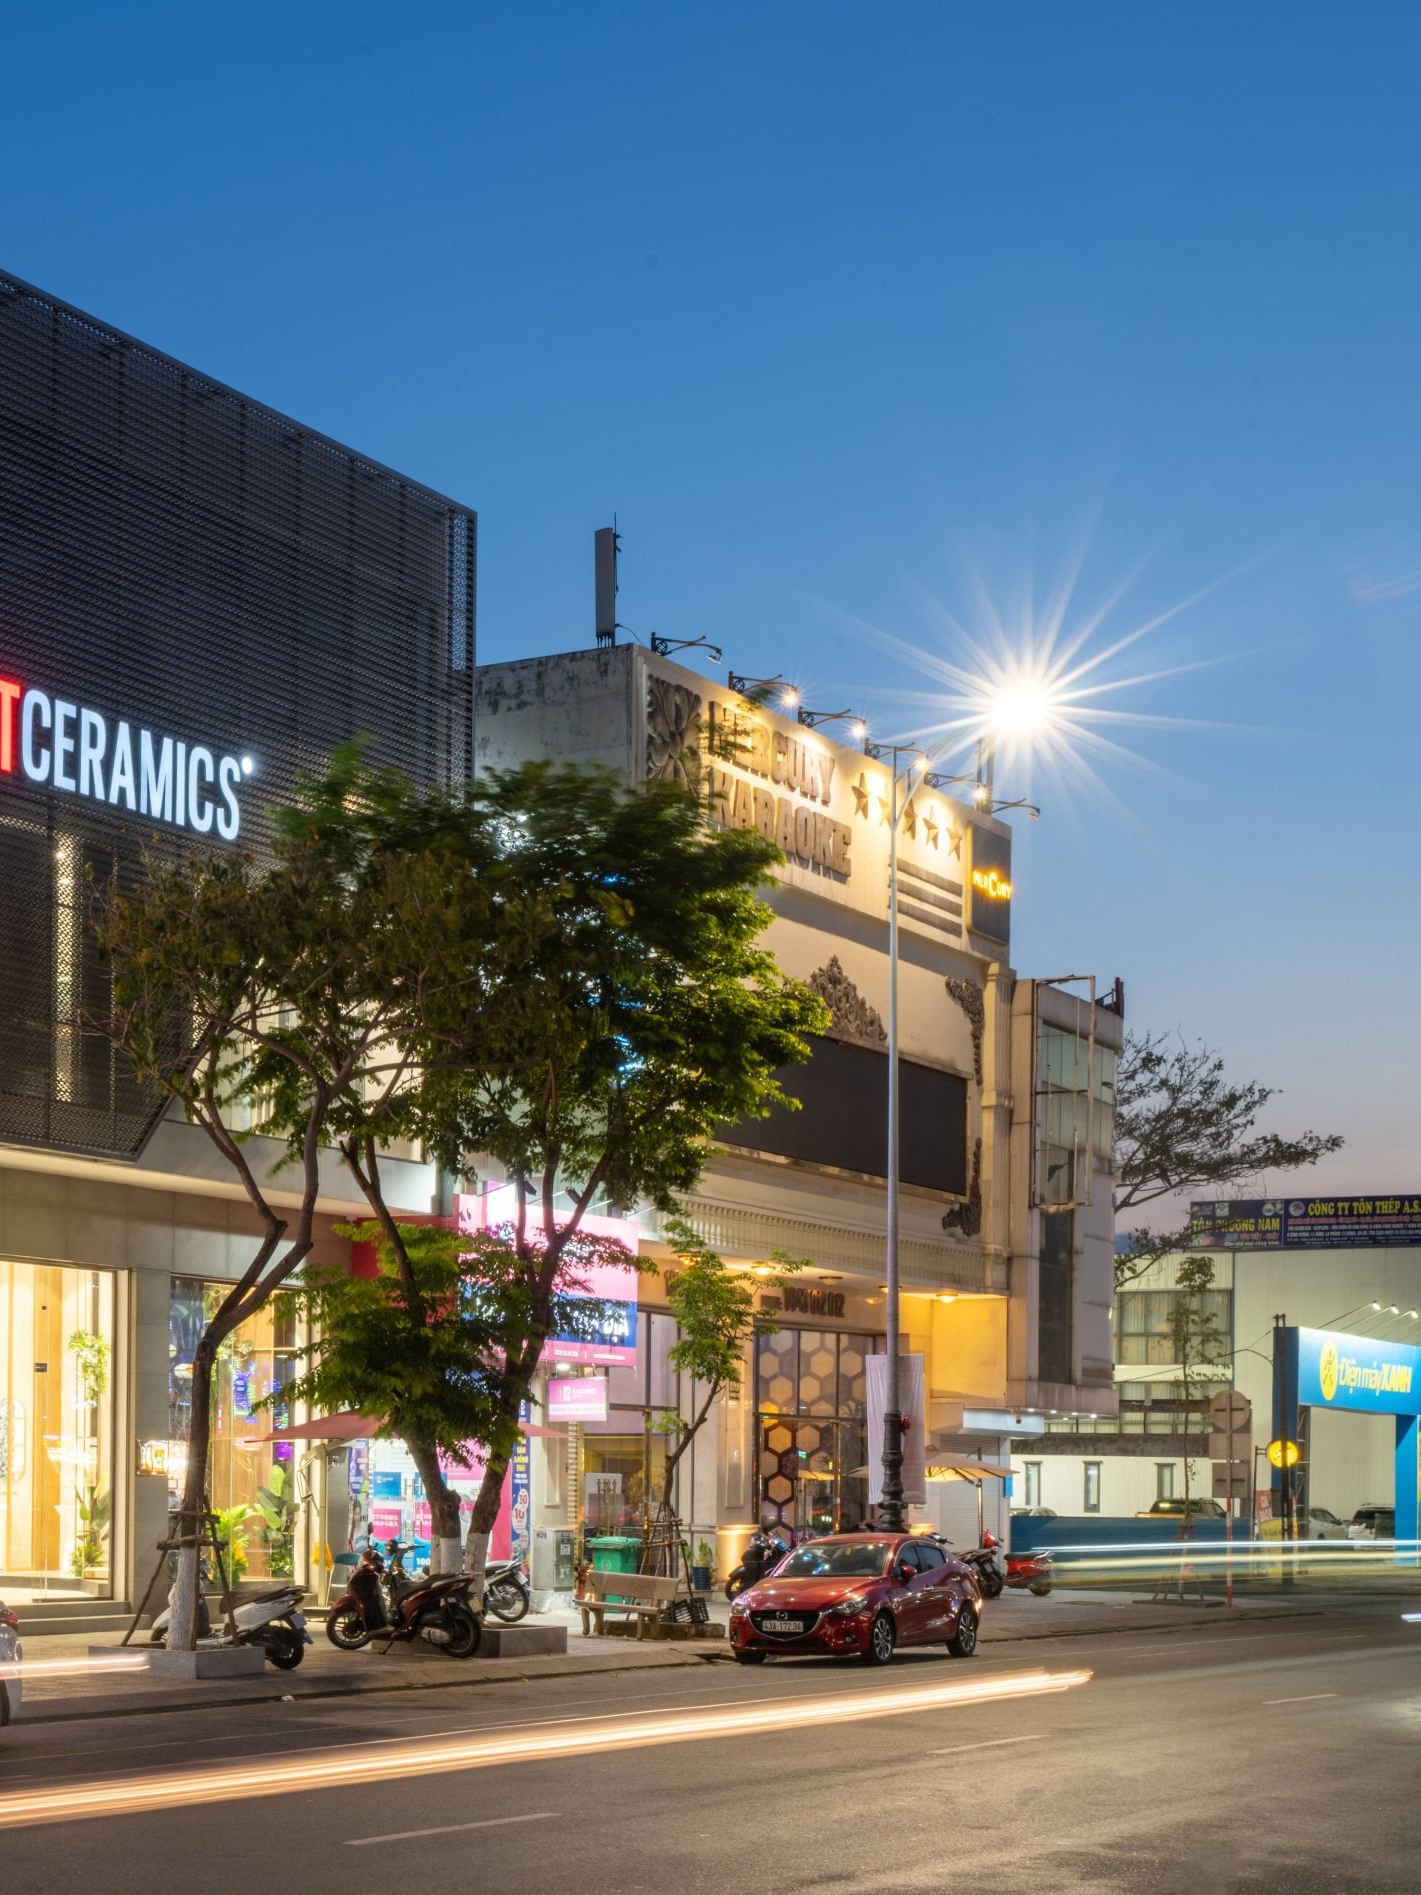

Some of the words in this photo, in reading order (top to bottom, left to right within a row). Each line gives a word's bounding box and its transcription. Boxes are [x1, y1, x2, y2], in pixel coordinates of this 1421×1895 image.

[1308, 1199, 1335, 1216] CÔNG
[1337, 1201, 1351, 1215] TY
[1352, 1198, 1374, 1215] TÔN
[1375, 1197, 1401, 1214] THÉP
[1258, 1217, 1280, 1231] NAM
[1380, 1363, 1413, 1393] XANH
